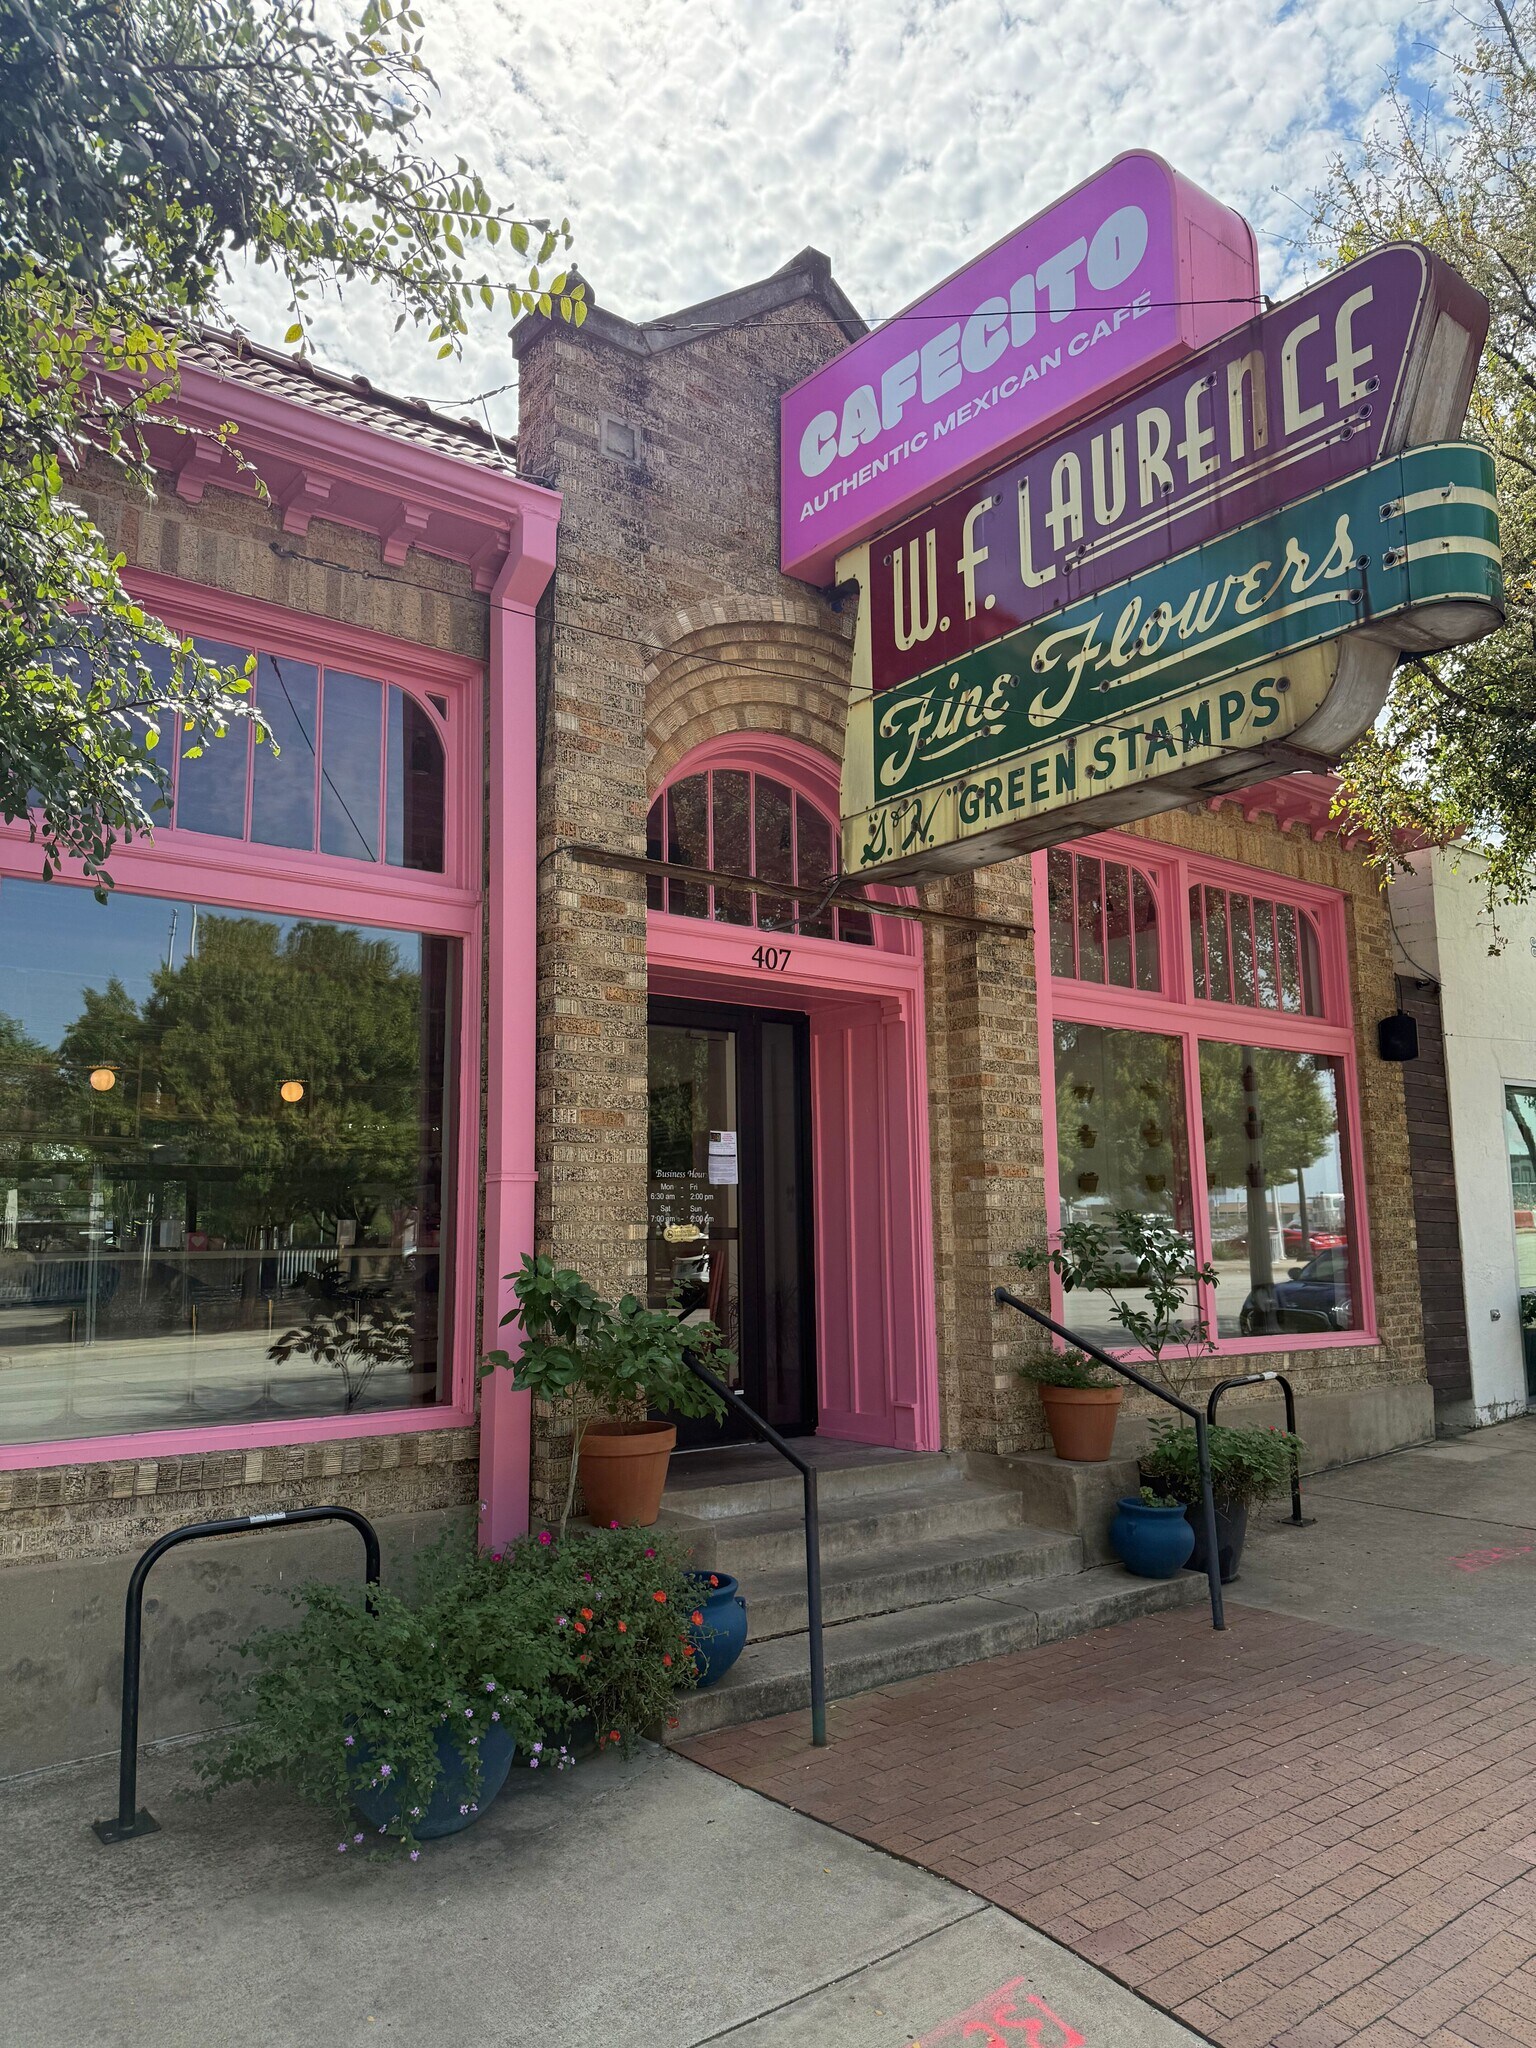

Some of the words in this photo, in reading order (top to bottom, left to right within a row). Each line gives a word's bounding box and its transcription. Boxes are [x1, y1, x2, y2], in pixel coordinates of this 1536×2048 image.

[799, 205, 1149, 477] CAFECITO
[799, 430, 929, 523] AUTHENTIC
[933, 347, 1062, 441] MEXICAN
[1067, 288, 1152, 357] CAFÉ
[1016, 284, 1374, 588] LAURENCE
[879, 672, 1012, 787] Fine
[1028, 513, 1358, 728] Flowers
[959, 746, 1077, 825] GREEN
[1092, 677, 1281, 781] STAMPS
[751, 946, 792, 972] 407
[650, 1192, 665, 1200] 6:30
[689, 1192, 704, 1200] 2:00
[704, 1194, 714, 1202] pm
[655, 1169, 686, 1178] Business
[660, 1204, 671, 1212] Sat
[689, 1204, 703, 1212] Sun
